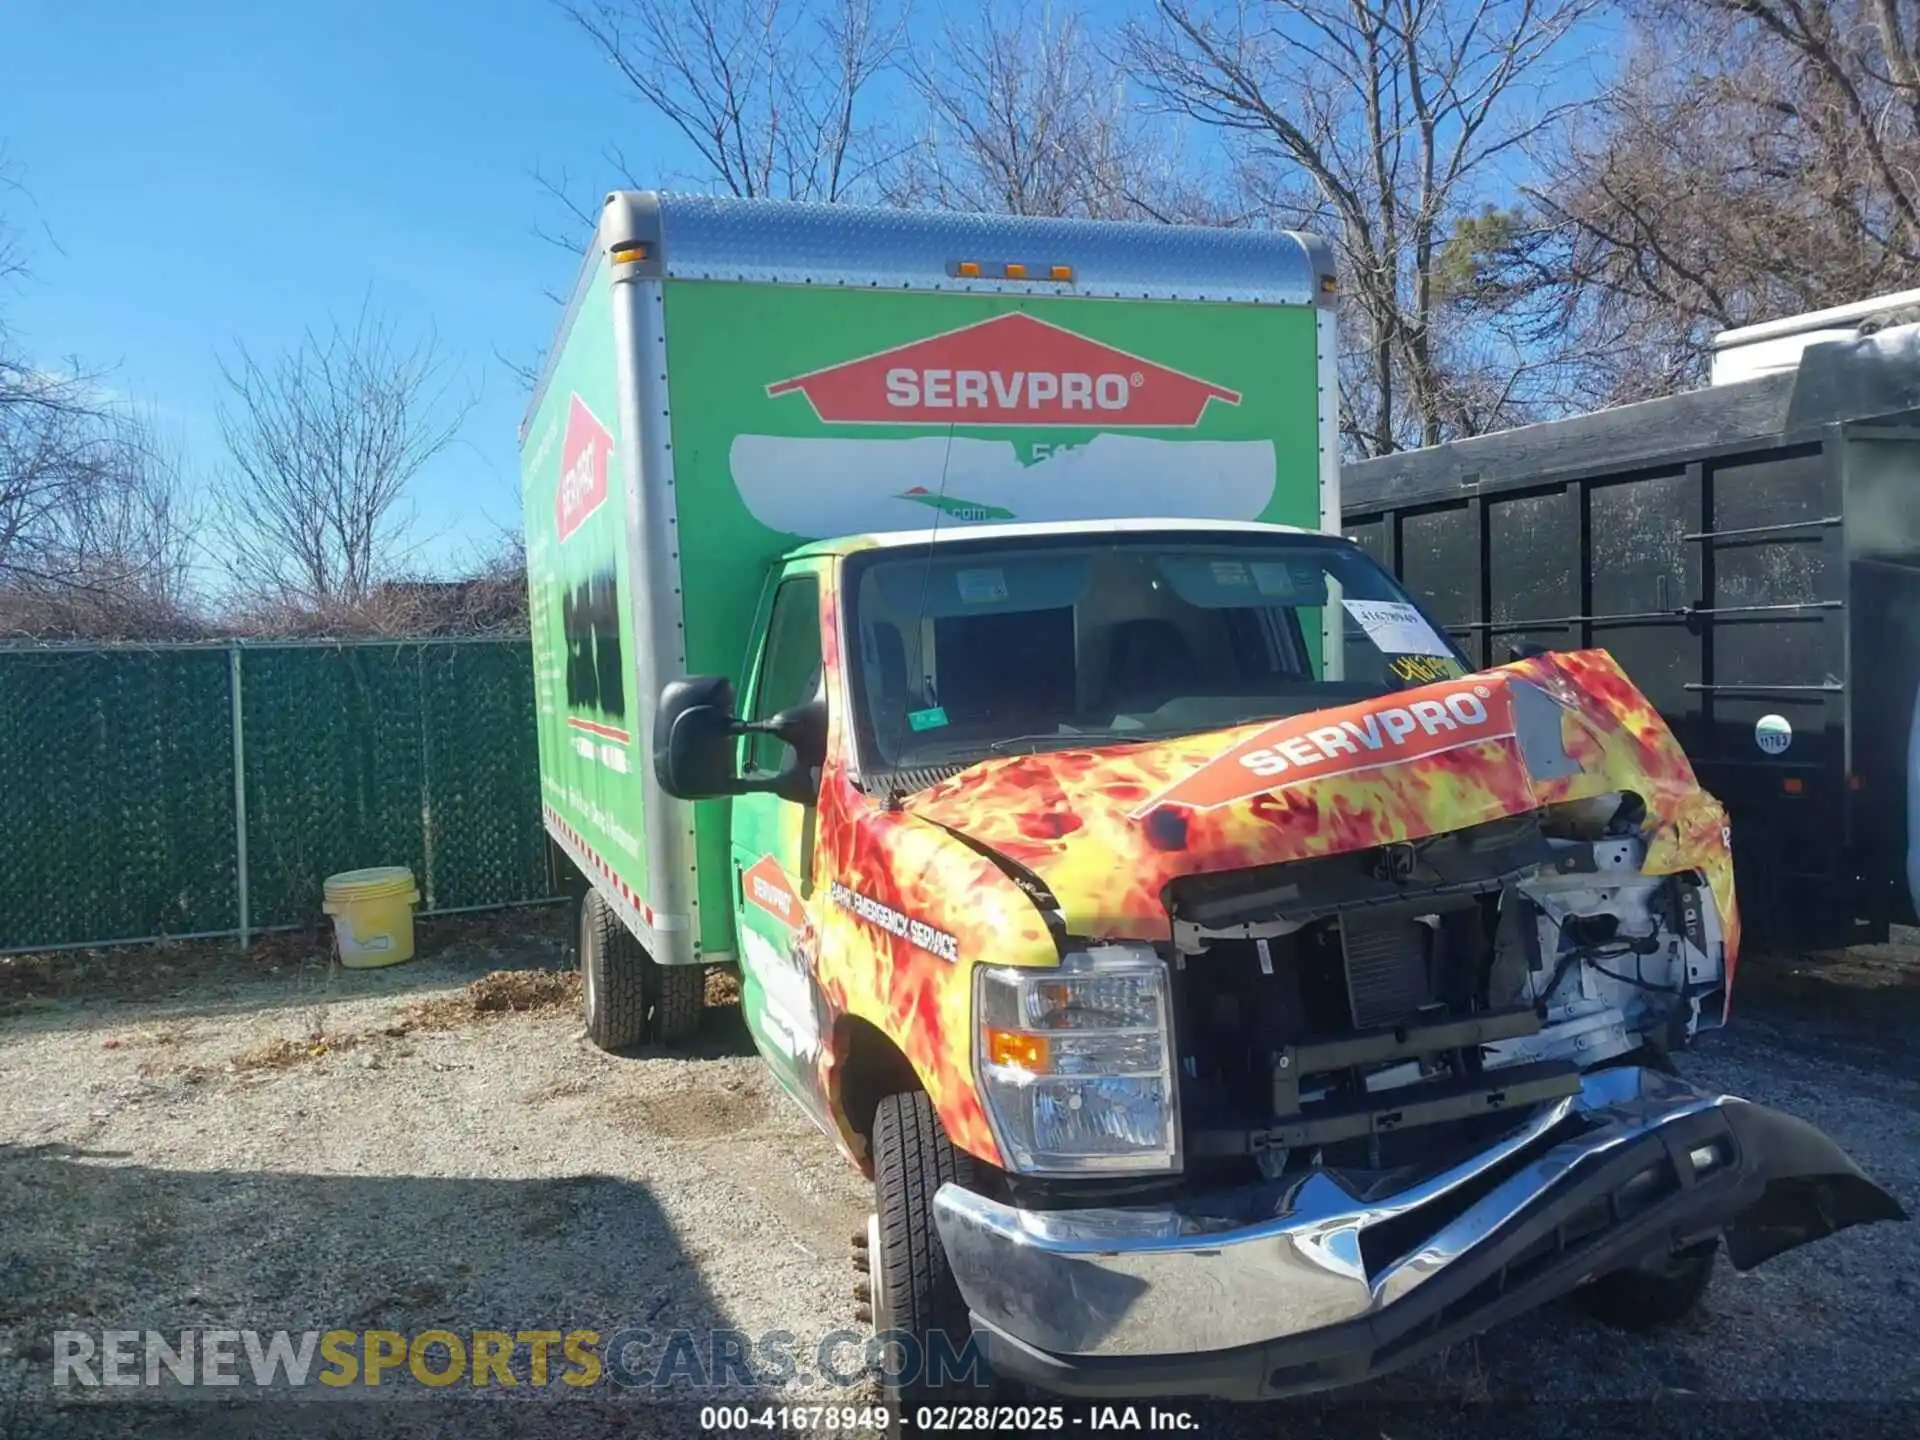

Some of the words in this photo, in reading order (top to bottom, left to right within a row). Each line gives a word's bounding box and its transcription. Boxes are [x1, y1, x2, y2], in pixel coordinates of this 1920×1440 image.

[886, 368, 1129, 410] SERVPRO
[1239, 692, 1487, 776] SERVPRO
[910, 919, 958, 963] SERVICE
